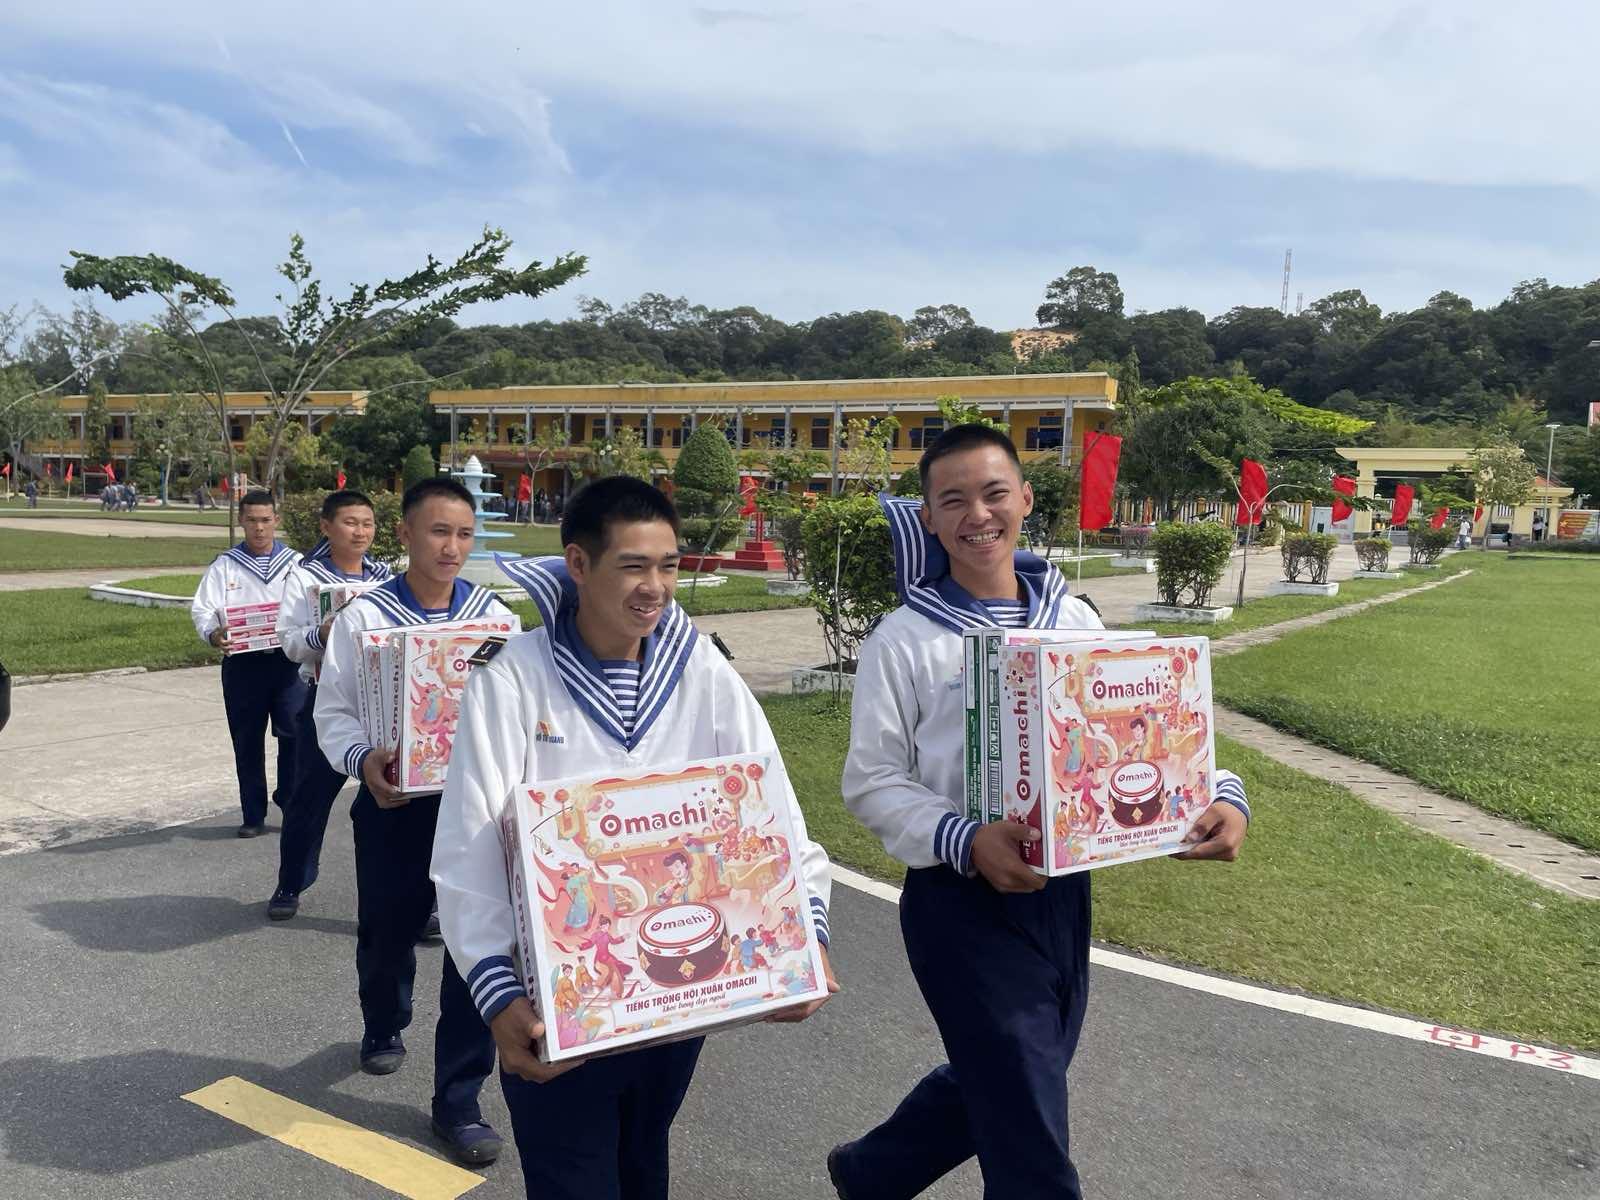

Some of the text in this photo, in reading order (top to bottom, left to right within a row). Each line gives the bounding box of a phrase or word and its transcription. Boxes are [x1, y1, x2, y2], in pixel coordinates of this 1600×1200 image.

[1092, 676, 1161, 699] Omachi
[1013, 690, 1031, 801] Omachi
[1118, 772, 1152, 783] Omachi
[600, 802, 706, 836] Omachi
[650, 914, 706, 932] Omachi
[700, 983, 724, 996] XUÂN
[725, 975, 757, 990] OMACHI
